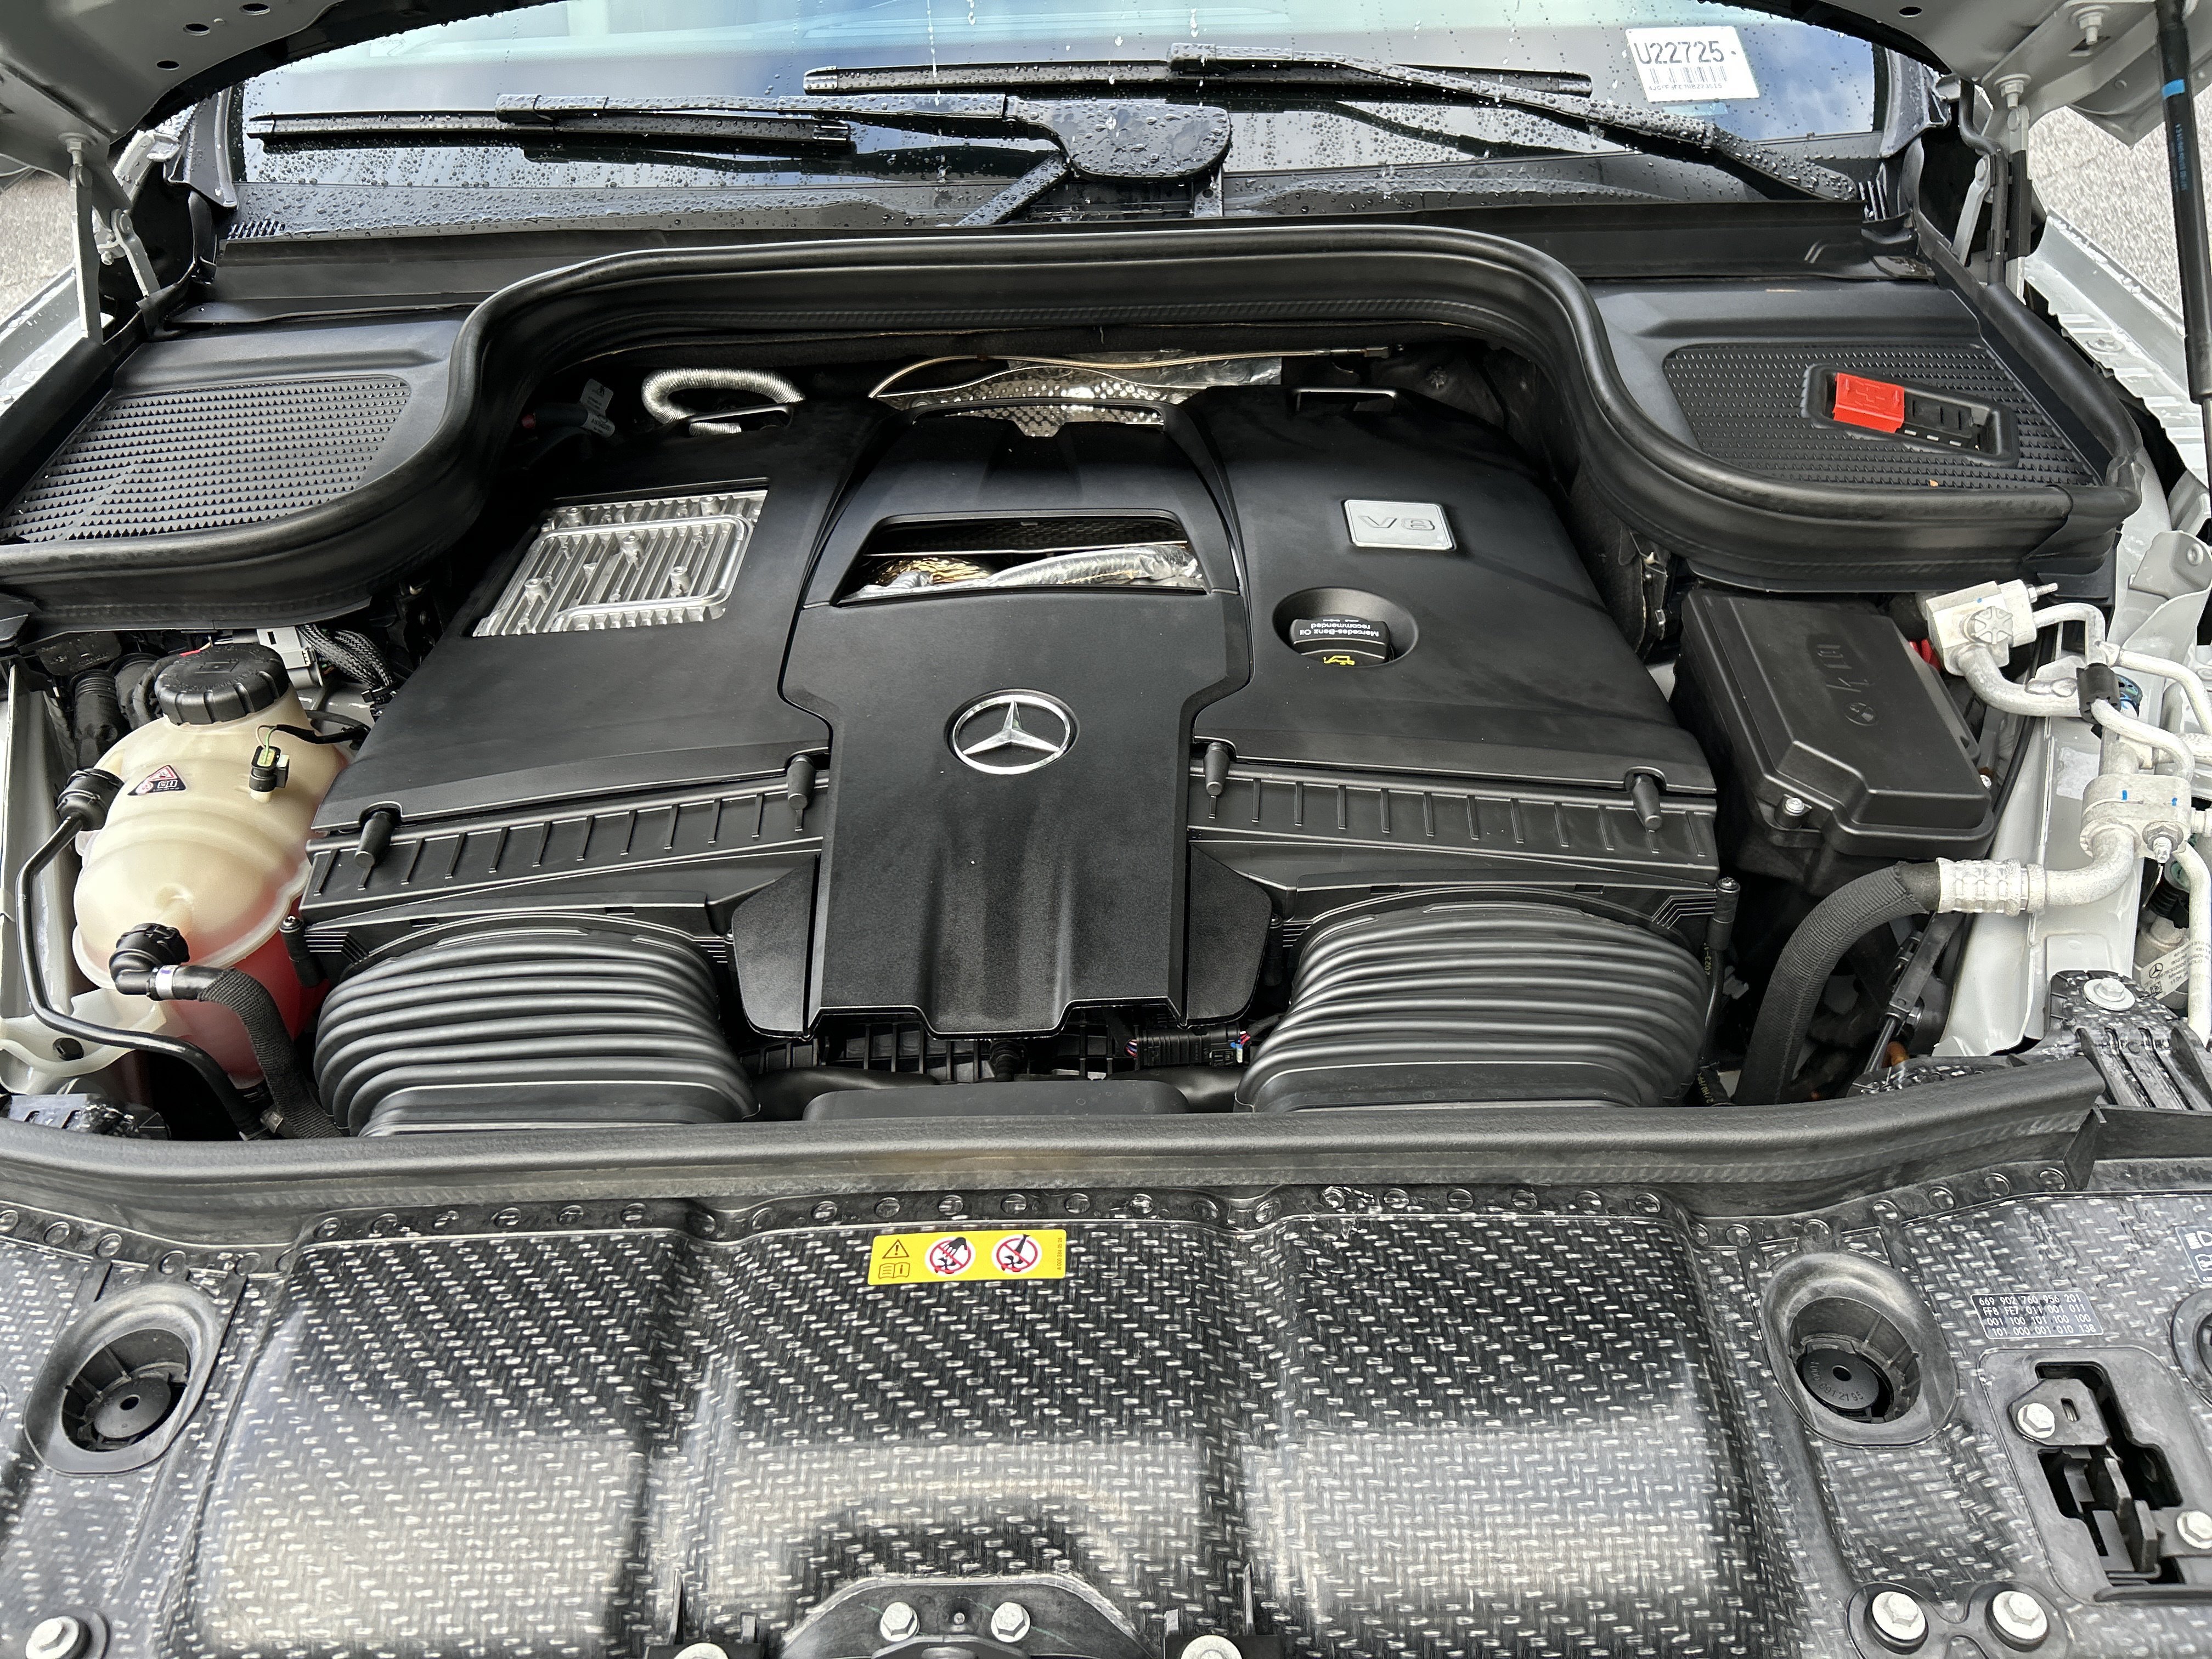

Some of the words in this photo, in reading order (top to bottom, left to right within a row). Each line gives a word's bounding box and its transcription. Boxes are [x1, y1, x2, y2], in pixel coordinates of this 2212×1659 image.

[1633, 40, 1725, 65] U22725
[1358, 515, 1435, 531] V8
[1313, 628, 1379, 637] Mercedes-Benz
[1979, 1297, 1995, 1305] 669
[2000, 1296, 2017, 1306] 902
[2021, 1295, 2038, 1305] 760
[2042, 1295, 2059, 1304] 956
[2064, 1294, 2081, 1302] 201
[1983, 1307, 1999, 1316] FF8
[2004, 1306, 2018, 1315] FE7
[2026, 1306, 2042, 1314] 011
[2047, 1305, 2064, 1313] 001
[2069, 1304, 2085, 1312] 011
[1987, 1317, 2003, 1326] 001
[2010, 1317, 2025, 1325] 100
[2031, 1316, 2047, 1324] 101
[2053, 1315, 2069, 1323] 100
[2074, 1314, 2091, 1323] 100
[1993, 1328, 2008, 1336] 101
[2013, 1327, 2029, 1335] 000
[2035, 1326, 2051, 1334] 001
[2057, 1325, 2073, 1334] 010
[2079, 1324, 2096, 1333] 138
